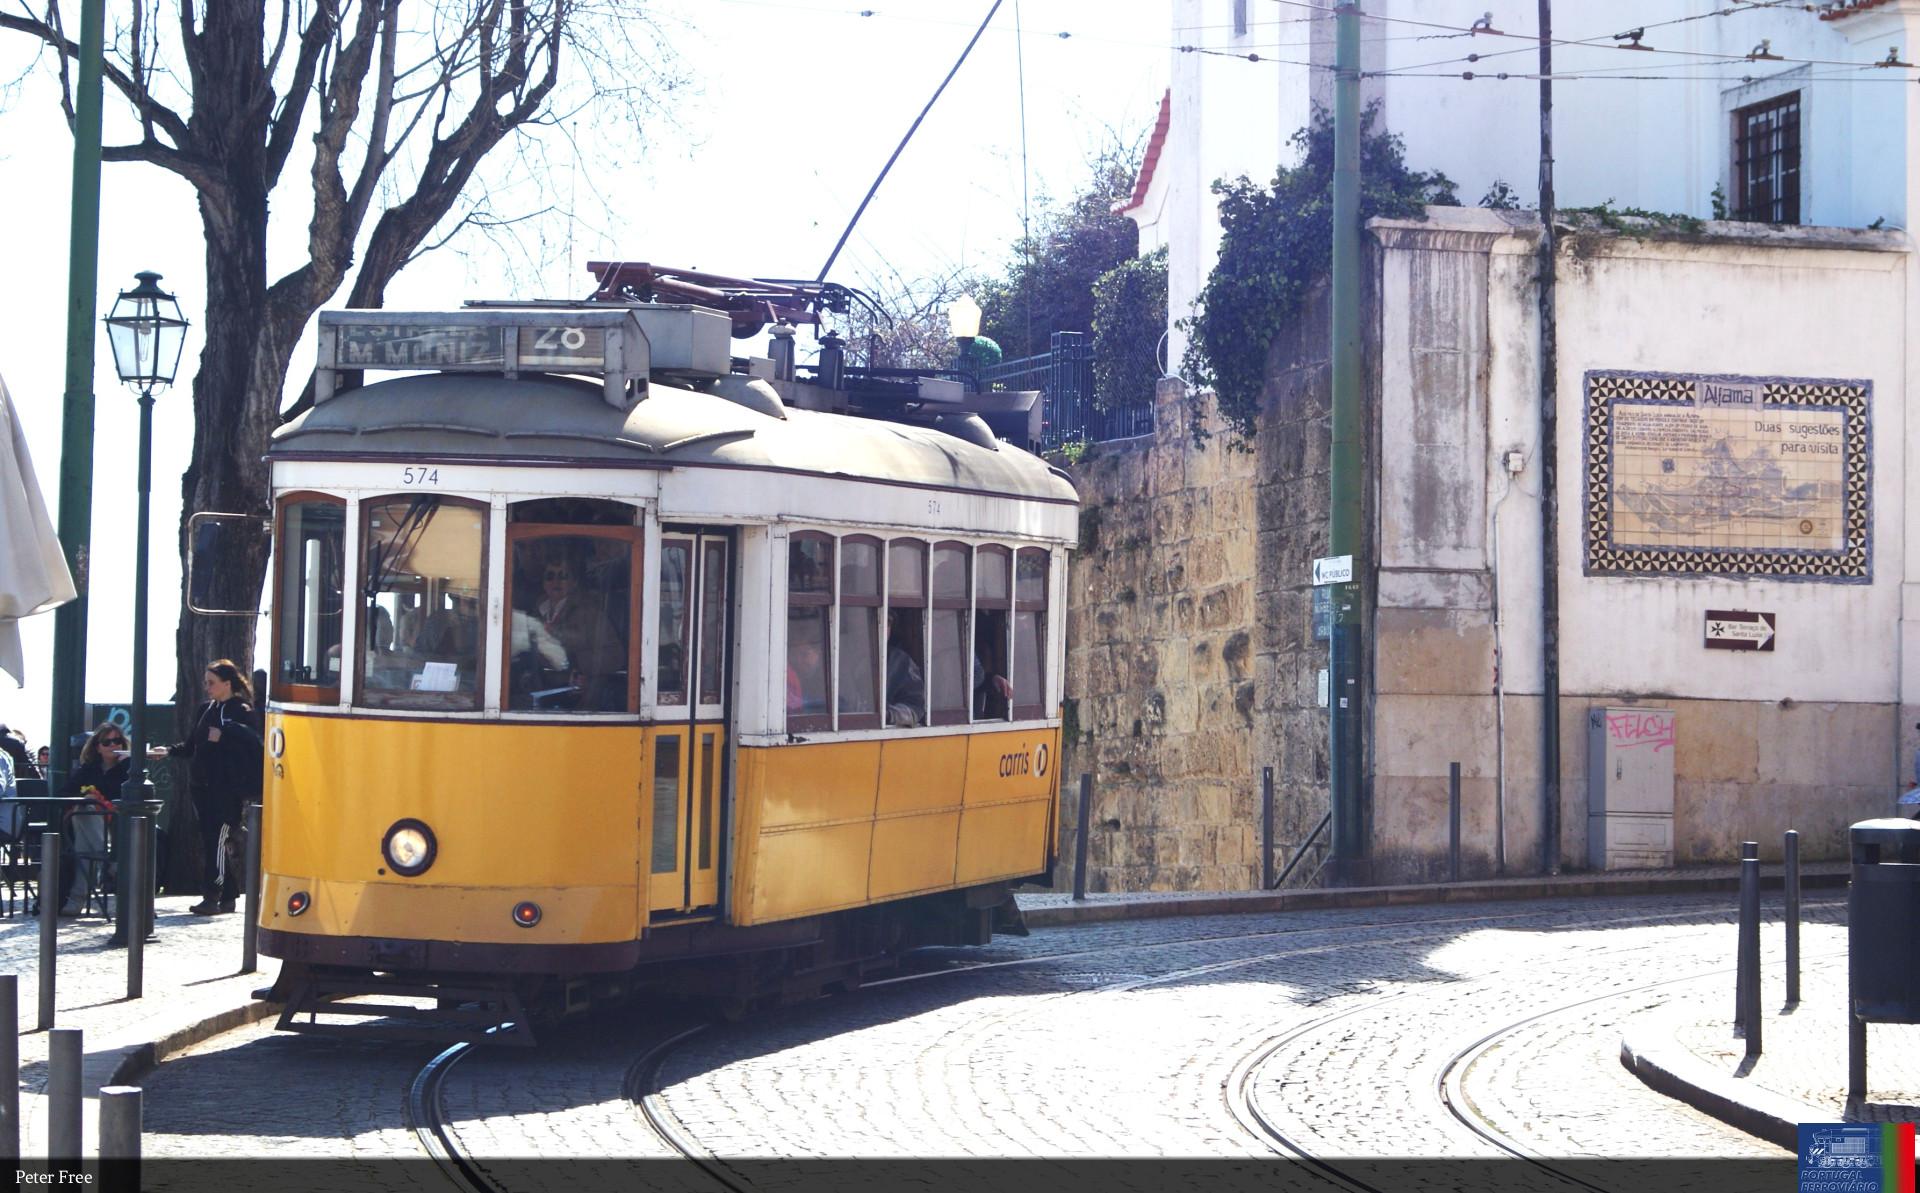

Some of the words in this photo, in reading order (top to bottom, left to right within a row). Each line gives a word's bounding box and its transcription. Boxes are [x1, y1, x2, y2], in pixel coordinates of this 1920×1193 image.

[1703, 384, 1754, 407] Alfama
[1754, 421, 1782, 433] Duas
[1788, 423, 1841, 440] sugestões
[1781, 443, 1807, 455] para
[1808, 444, 1839, 455] visita
[403, 466, 439, 485] 574
[999, 742, 1030, 778] carris
